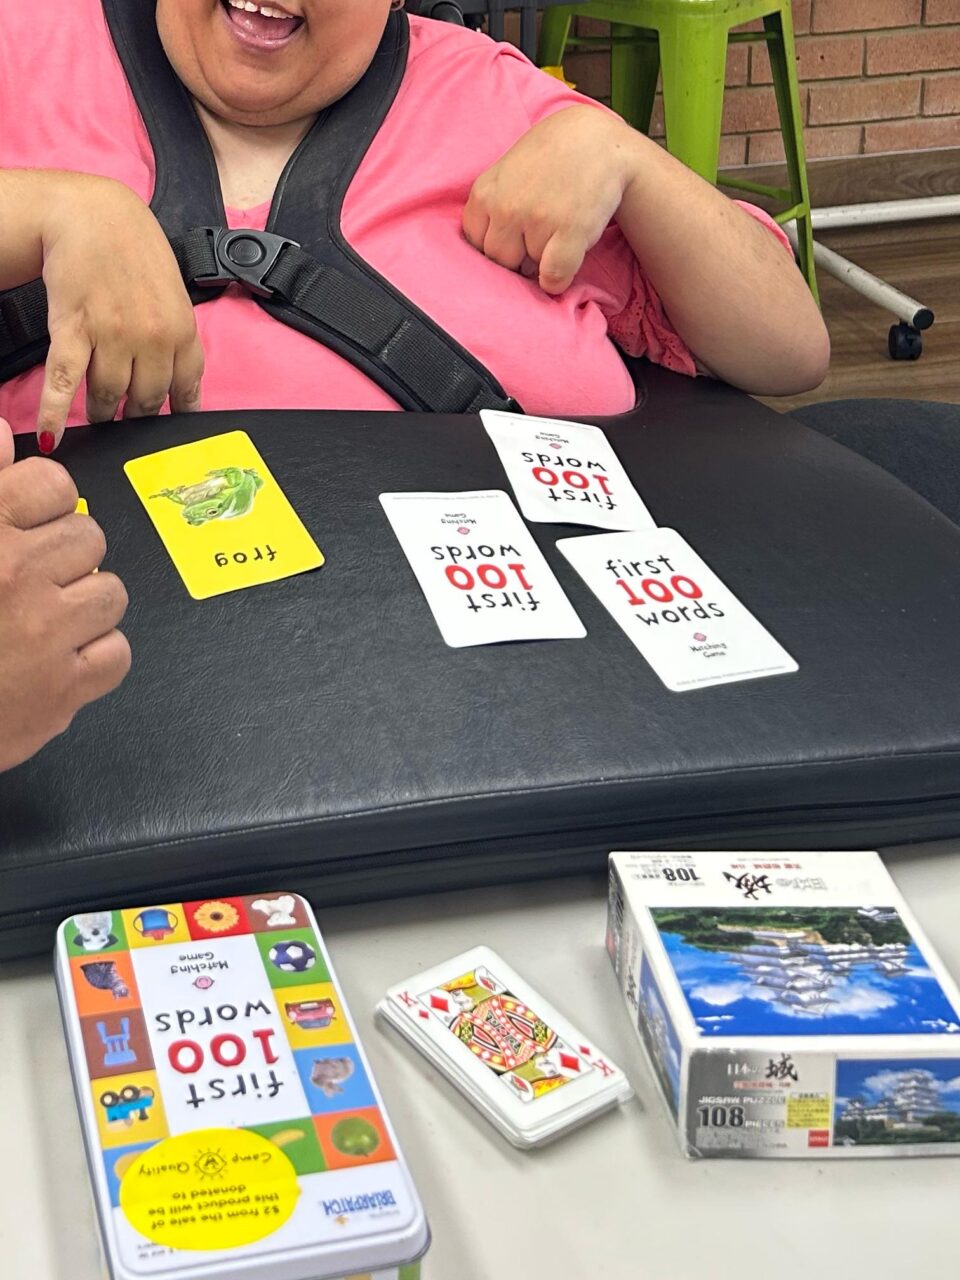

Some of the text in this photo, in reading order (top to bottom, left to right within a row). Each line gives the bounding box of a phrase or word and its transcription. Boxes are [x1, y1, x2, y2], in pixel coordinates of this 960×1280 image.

[534, 434, 570, 444] Matching
[521, 452, 607, 472] words
[531, 466, 614, 496] 100
[548, 487, 617, 510] first
[440, 517, 477, 525] Matching
[214, 544, 278, 568] frog
[430, 544, 522, 564] words
[444, 563, 533, 591] 100
[606, 554, 675, 578] first
[616, 574, 703, 606] 100
[466, 591, 540, 613] first
[635, 600, 726, 627] words
[690, 640, 728, 653] Matching
[703, 651, 726, 659] Game
[662, 868, 702, 881] 108
[178, 951, 215, 961] Game
[170, 960, 229, 975] Matching
[397, 991, 418, 1008] K
[155, 999, 272, 1034] words
[167, 1027, 279, 1075] 100
[593, 1060, 614, 1077] K
[186, 1070, 284, 1108] first
[699, 1096, 740, 1104] JIGSAW
[697, 1105, 745, 1127] 108
[138, 1151, 273, 1176] Camp Quality
[172, 1183, 247, 1200] donated to
[148, 1192, 280, 1216] this product will be
[151, 1205, 280, 1230] $2 from the sale of
